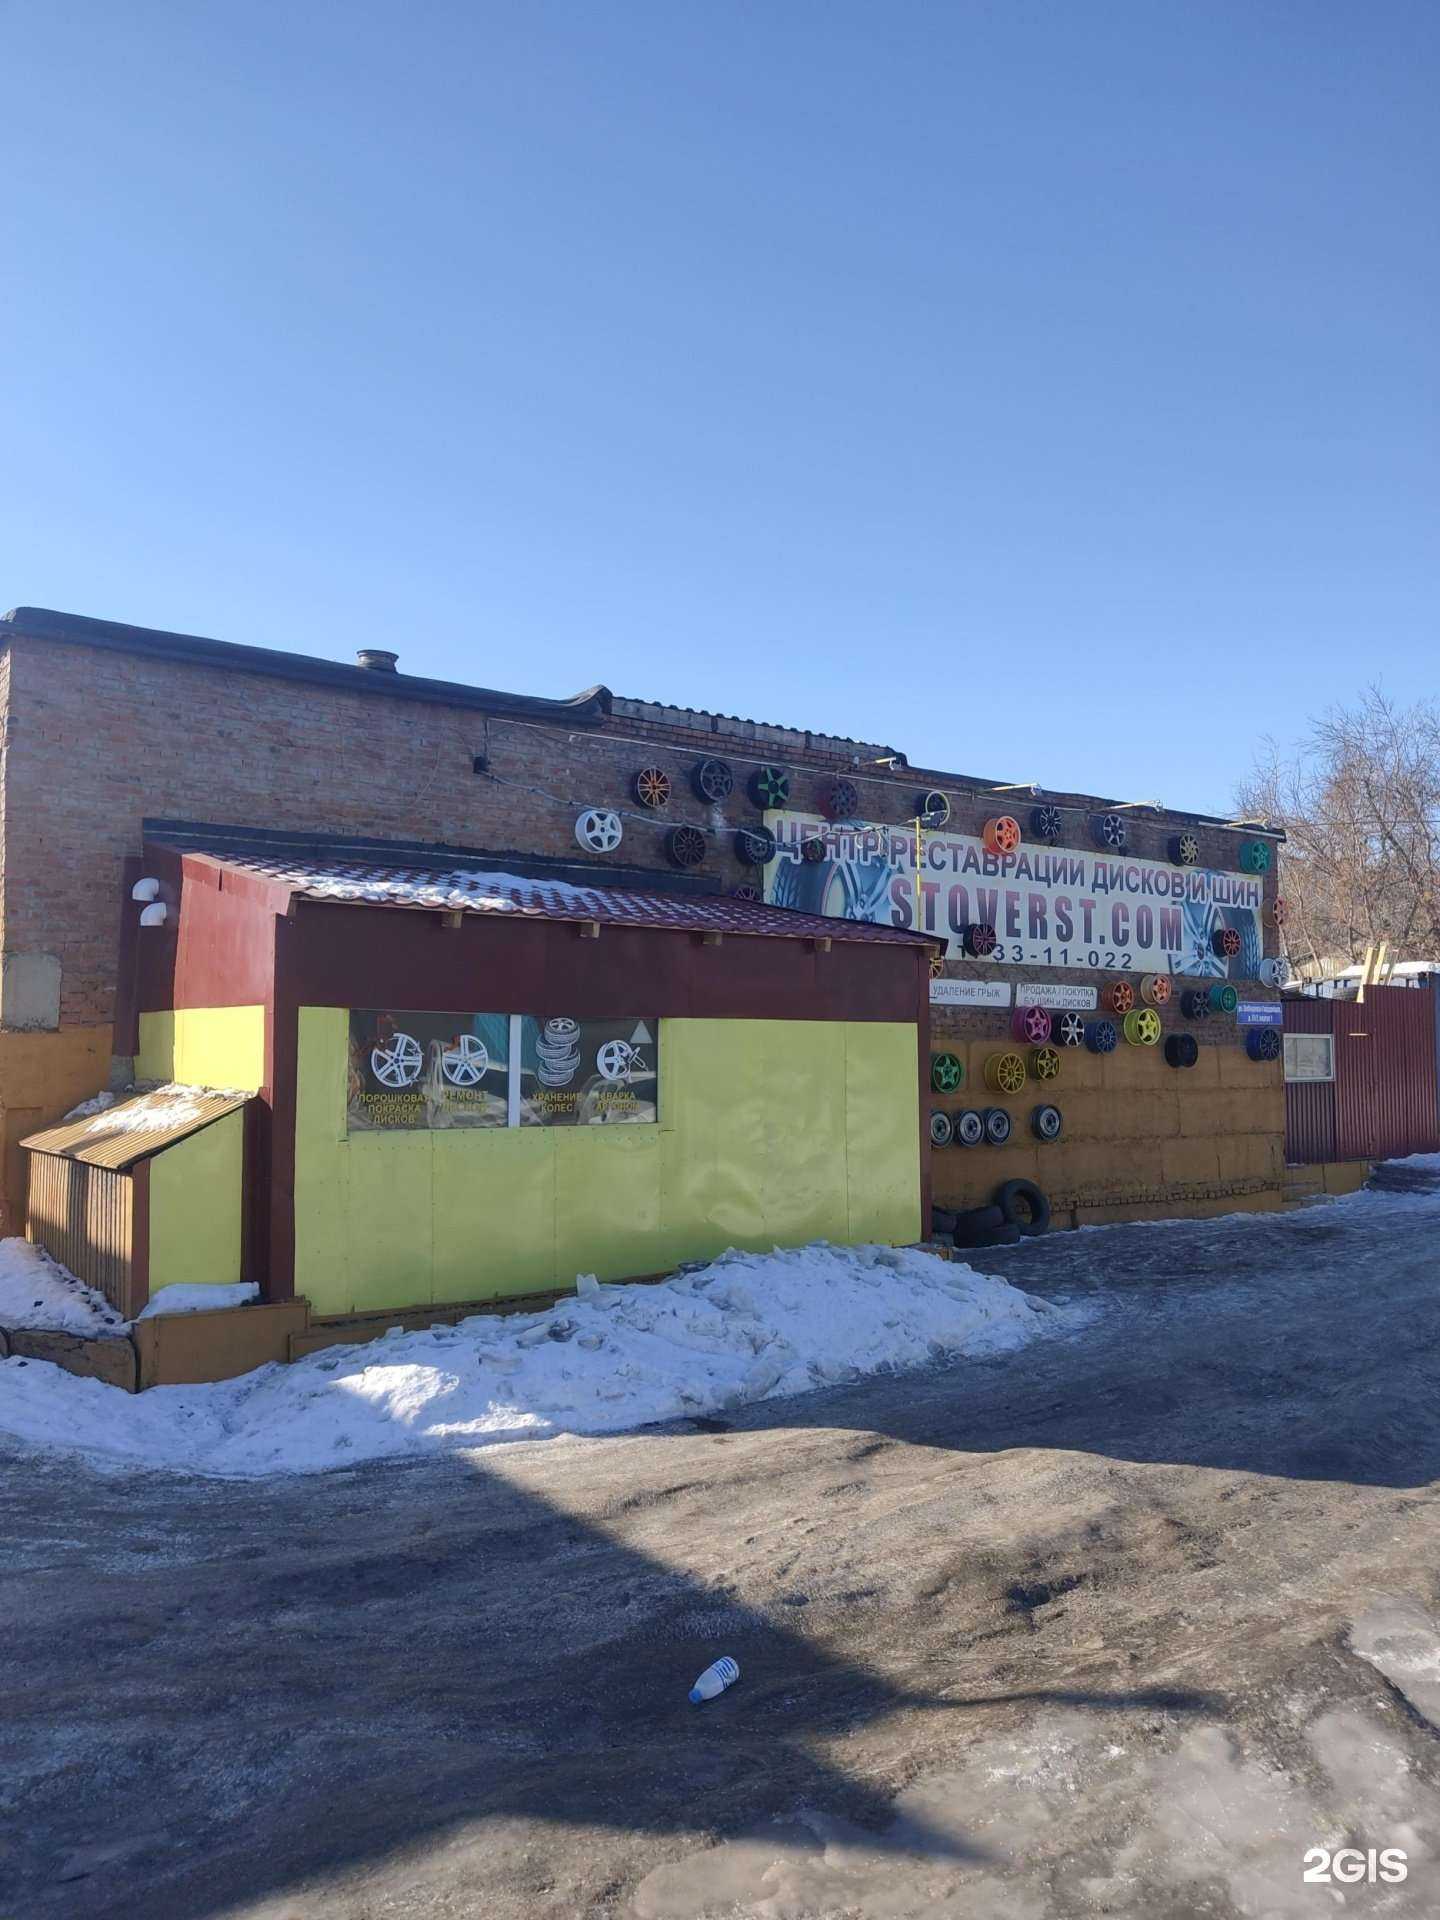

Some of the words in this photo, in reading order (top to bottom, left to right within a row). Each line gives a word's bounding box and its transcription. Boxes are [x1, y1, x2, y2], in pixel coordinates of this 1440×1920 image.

[889, 834, 1085, 888] РЕСТАВРАЦИИ
[1092, 861, 1185, 898] ДИСКОВ
[1191, 873, 1205, 902] И
[1212, 875, 1259, 907] ШИН
[890, 877, 1183, 951] STOVERST.COM
[992, 943, 1132, 969] 33-11-022
[933, 985, 976, 997] УДАЛЕНИЕ
[977, 987, 1001, 998] ГРЫЖ
[1020, 984, 1057, 995] ПРОДАЖА
[1062, 986, 1095, 997] ПОКУПКА
[1062, 998, 1092, 1008] ДИСКОВ
[358, 1093, 431, 1103] ПОРОШКОВАЯ
[443, 1089, 489, 1101] РЕМОНТ
[533, 1092, 583, 1102] ХРАНЕНИЕ
[368, 1104, 422, 1114] ПОКРАСКА
[541, 1103, 574, 1113] КОЛЕС
[374, 1114, 416, 1124] ДИСКОВ
